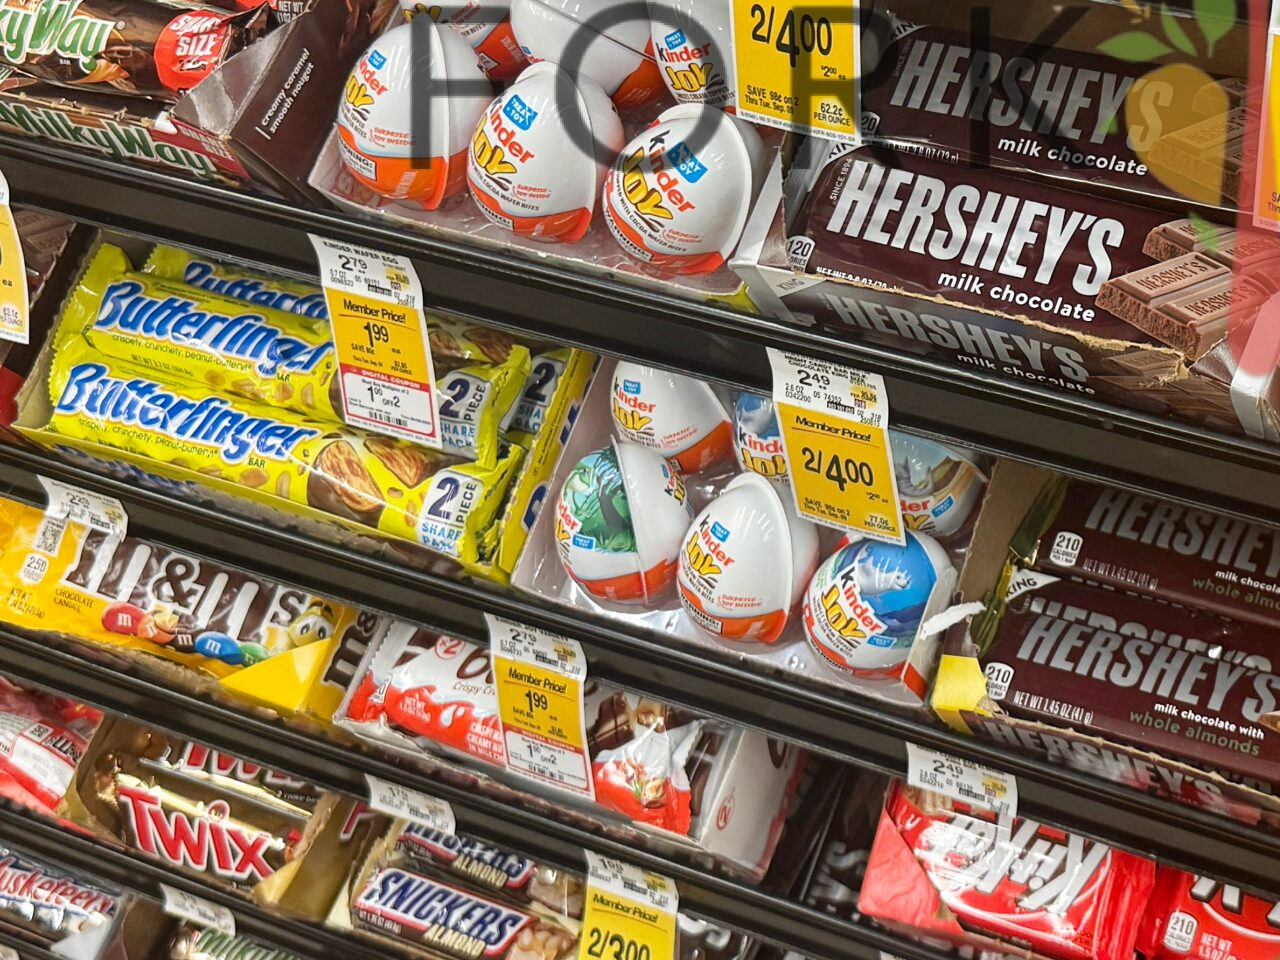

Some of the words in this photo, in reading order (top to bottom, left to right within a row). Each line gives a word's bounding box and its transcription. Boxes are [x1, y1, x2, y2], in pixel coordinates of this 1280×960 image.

[176, 34, 216, 58] SIZE
[261, 94, 292, 127] creamy
[284, 47, 310, 95] caramel
[269, 101, 295, 134] smooth
[292, 62, 315, 104] nougat
[890, 39, 1173, 152] HERSHEY'S
[826, 159, 1125, 296] HERSHEY'S
[343, 299, 380, 318] Member
[381, 307, 406, 323] Price!
[938, 271, 984, 294] milk
[989, 284, 1095, 323] chocolate
[55, 362, 319, 461] Butterfinger
[1056, 535, 1080, 551] 210
[1129, 711, 1179, 737] whole
[1185, 723, 1260, 757] almonds
[1154, 702, 1178, 718] milk
[1181, 709, 1236, 733] chocolate
[1239, 723, 1265, 740] with
[362, 871, 523, 946] SNICKERS
[422, 924, 486, 957] ALMOND
